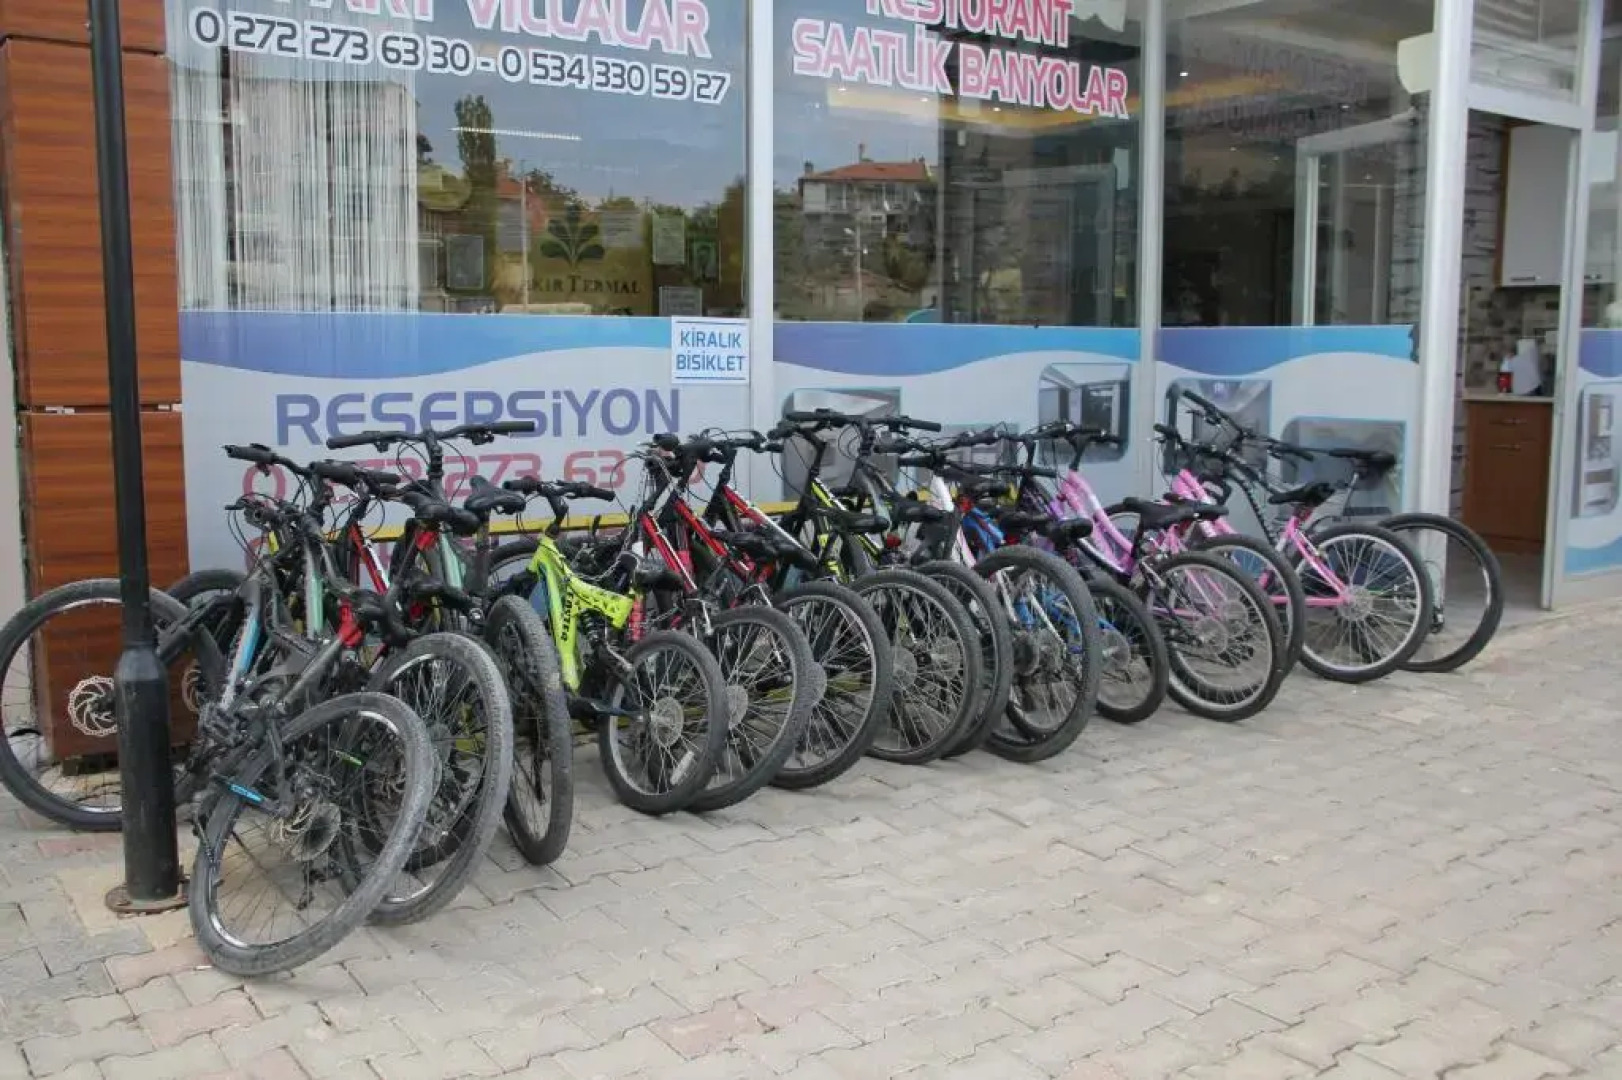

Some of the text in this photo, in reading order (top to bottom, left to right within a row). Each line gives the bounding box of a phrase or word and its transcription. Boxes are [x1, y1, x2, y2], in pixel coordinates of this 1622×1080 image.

[193, 9, 222, 45] 0
[231, 13, 300, 54] 272
[307, 24, 371, 63] 273
[379, 33, 423, 68] 63
[428, 38, 472, 74] 30
[499, 47, 524, 79] 0
[531, 51, 588, 87] 534
[593, 57, 648, 93] 330
[653, 66, 689, 97] 59
[694, 70, 729, 101] 27
[792, 19, 952, 94] SAATLİK
[959, 42, 1128, 119] BANYOLAR
[676, 350, 746, 371] BİSİKLET
[680, 327, 742, 348] KİRALIK
